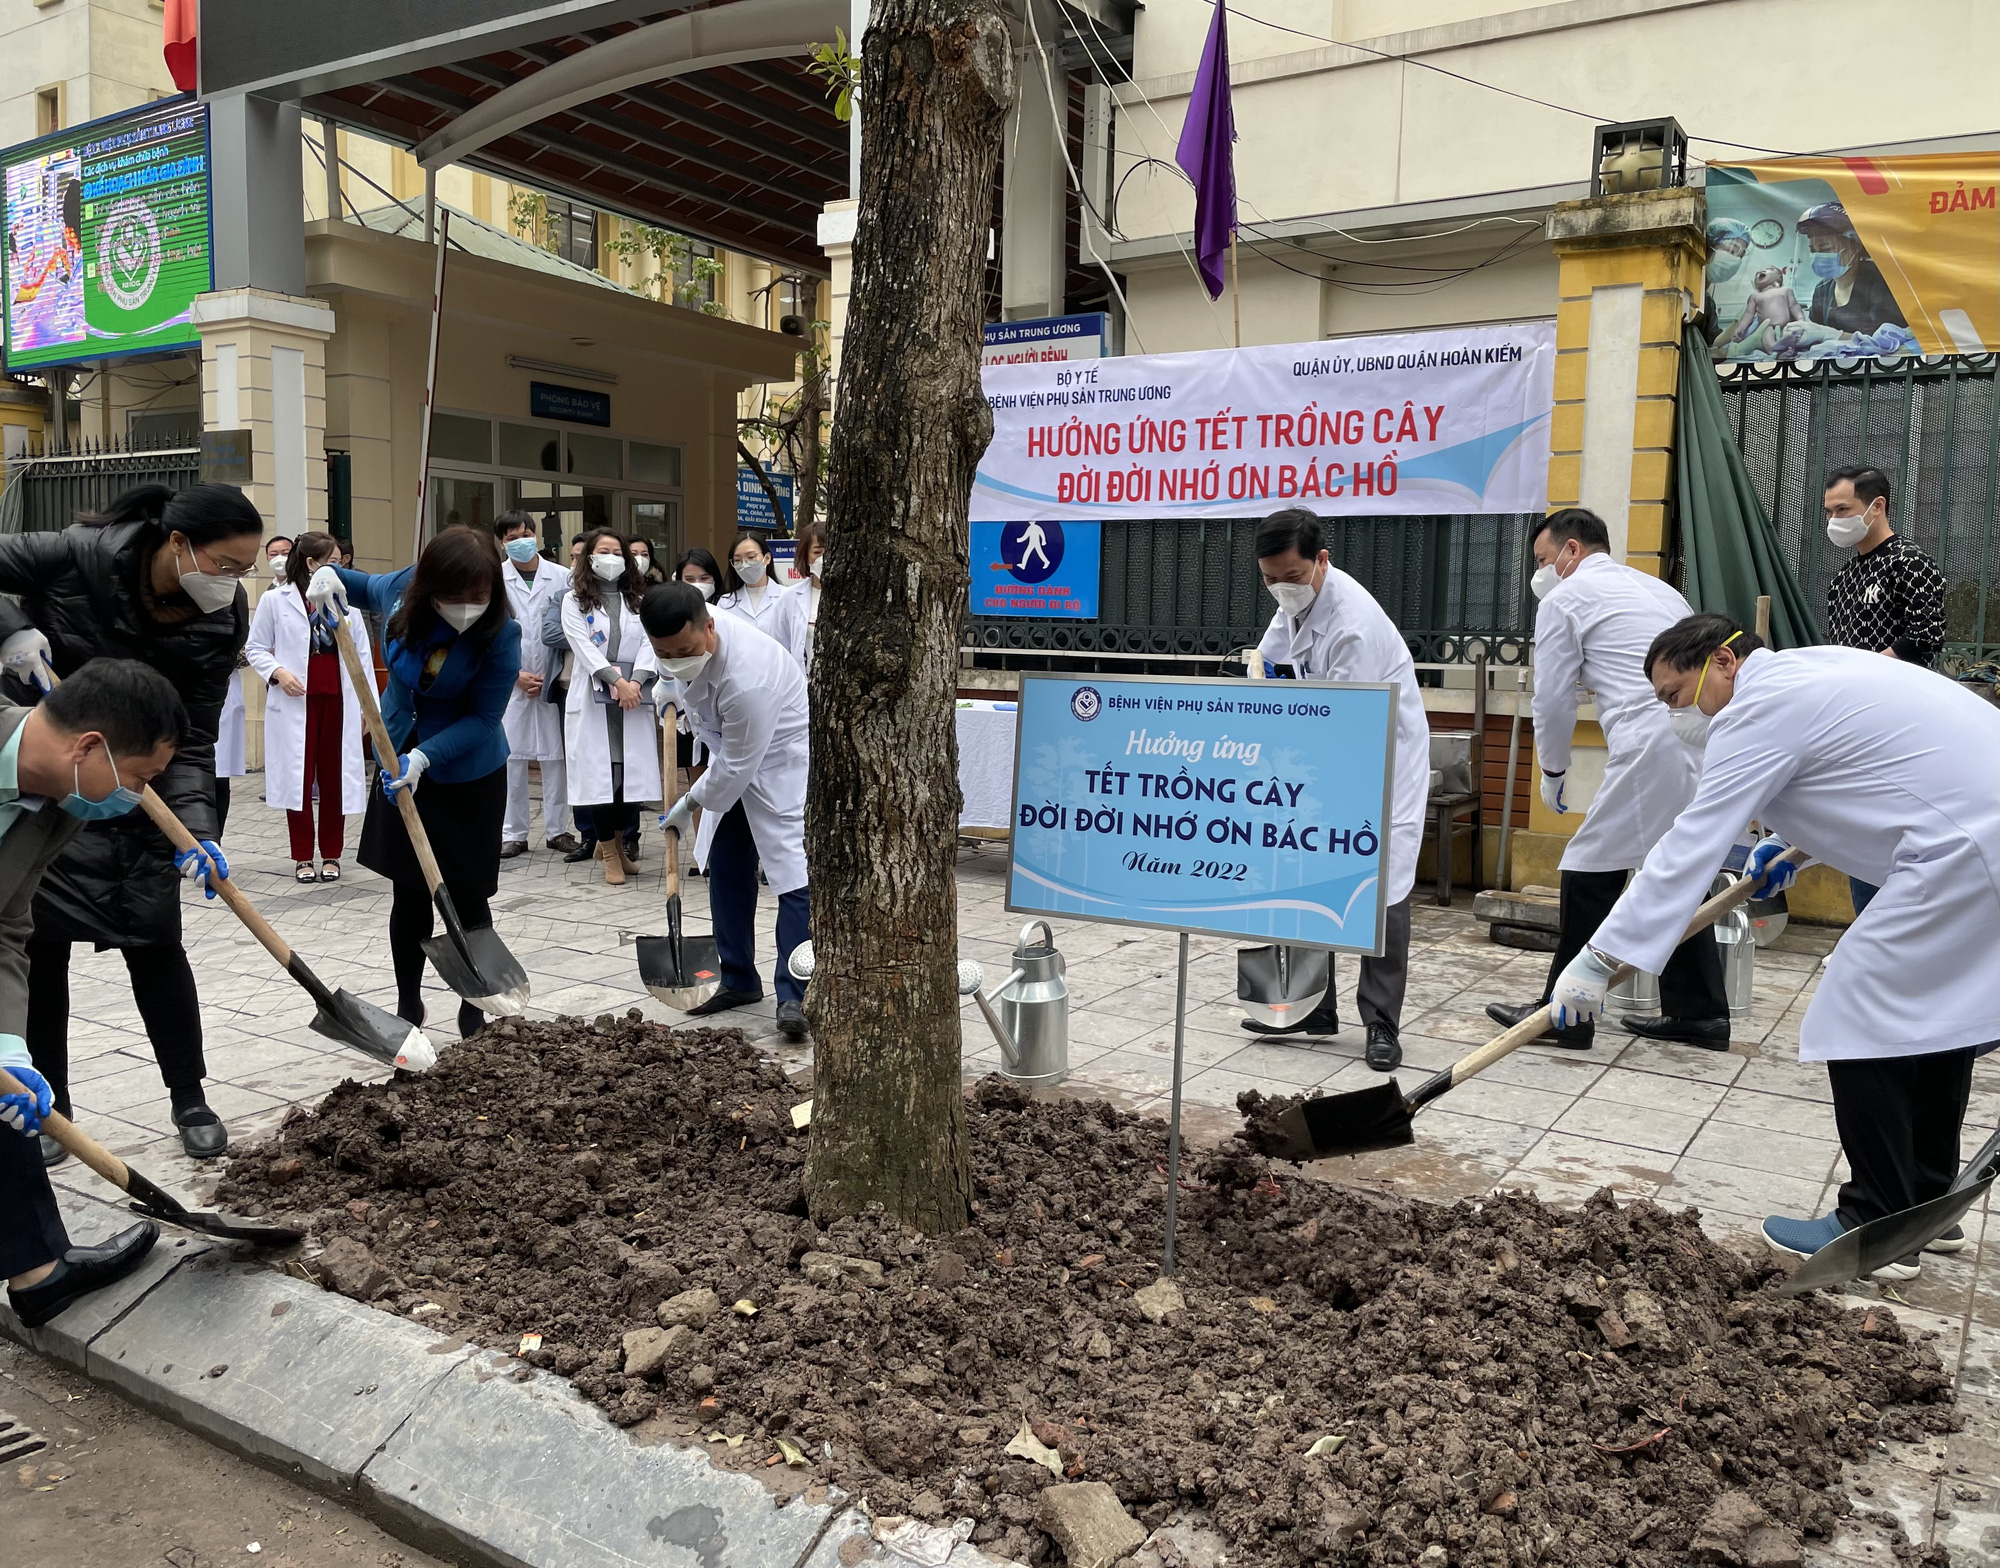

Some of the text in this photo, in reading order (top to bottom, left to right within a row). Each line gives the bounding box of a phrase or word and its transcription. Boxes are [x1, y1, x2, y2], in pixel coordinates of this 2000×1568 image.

[1929, 181, 1996, 214] ĐẢM
[984, 323, 1081, 343] HỤ SẢN TRUNG ƯƠNG
[1293, 342, 1523, 378] QUẬN ỦY, UBND QUẬN HOÀN KIẾM
[1056, 366, 1099, 388] BỘ Y TẾ
[988, 384, 1172, 411] BỆNH VIỆN PHỤ SẢN TRUNG ƯƠNG
[1027, 400, 1446, 458] HƯỞNG ỨNG TẾT TRỒNG CÂY
[1057, 449, 1399, 504] ĐỜI ĐỜI NHỚ ƠN BÁC HỒ
[985, 596, 1081, 612] CHO NGƯỜI ĐI BỘ
[995, 583, 1071, 596] ĐƯỜNG DÀNH
[1108, 695, 1141, 714] BỆNH
[1144, 696, 1173, 714] VIỆN
[1177, 699, 1203, 715] PHỤ
[1206, 697, 1234, 713] SẢN
[1237, 702, 1284, 716] TRUNG
[1287, 702, 1331, 717] ƯƠNG
[1125, 728, 1262, 767] Hưởng ứng
[1085, 760, 1305, 808] TẾT TRỒNG CÂY
[1019, 799, 1379, 857] ĐỜI ĐỜI NHỚ ƠN BÁC HỒ
[1122, 850, 1249, 882] Năm 2022
